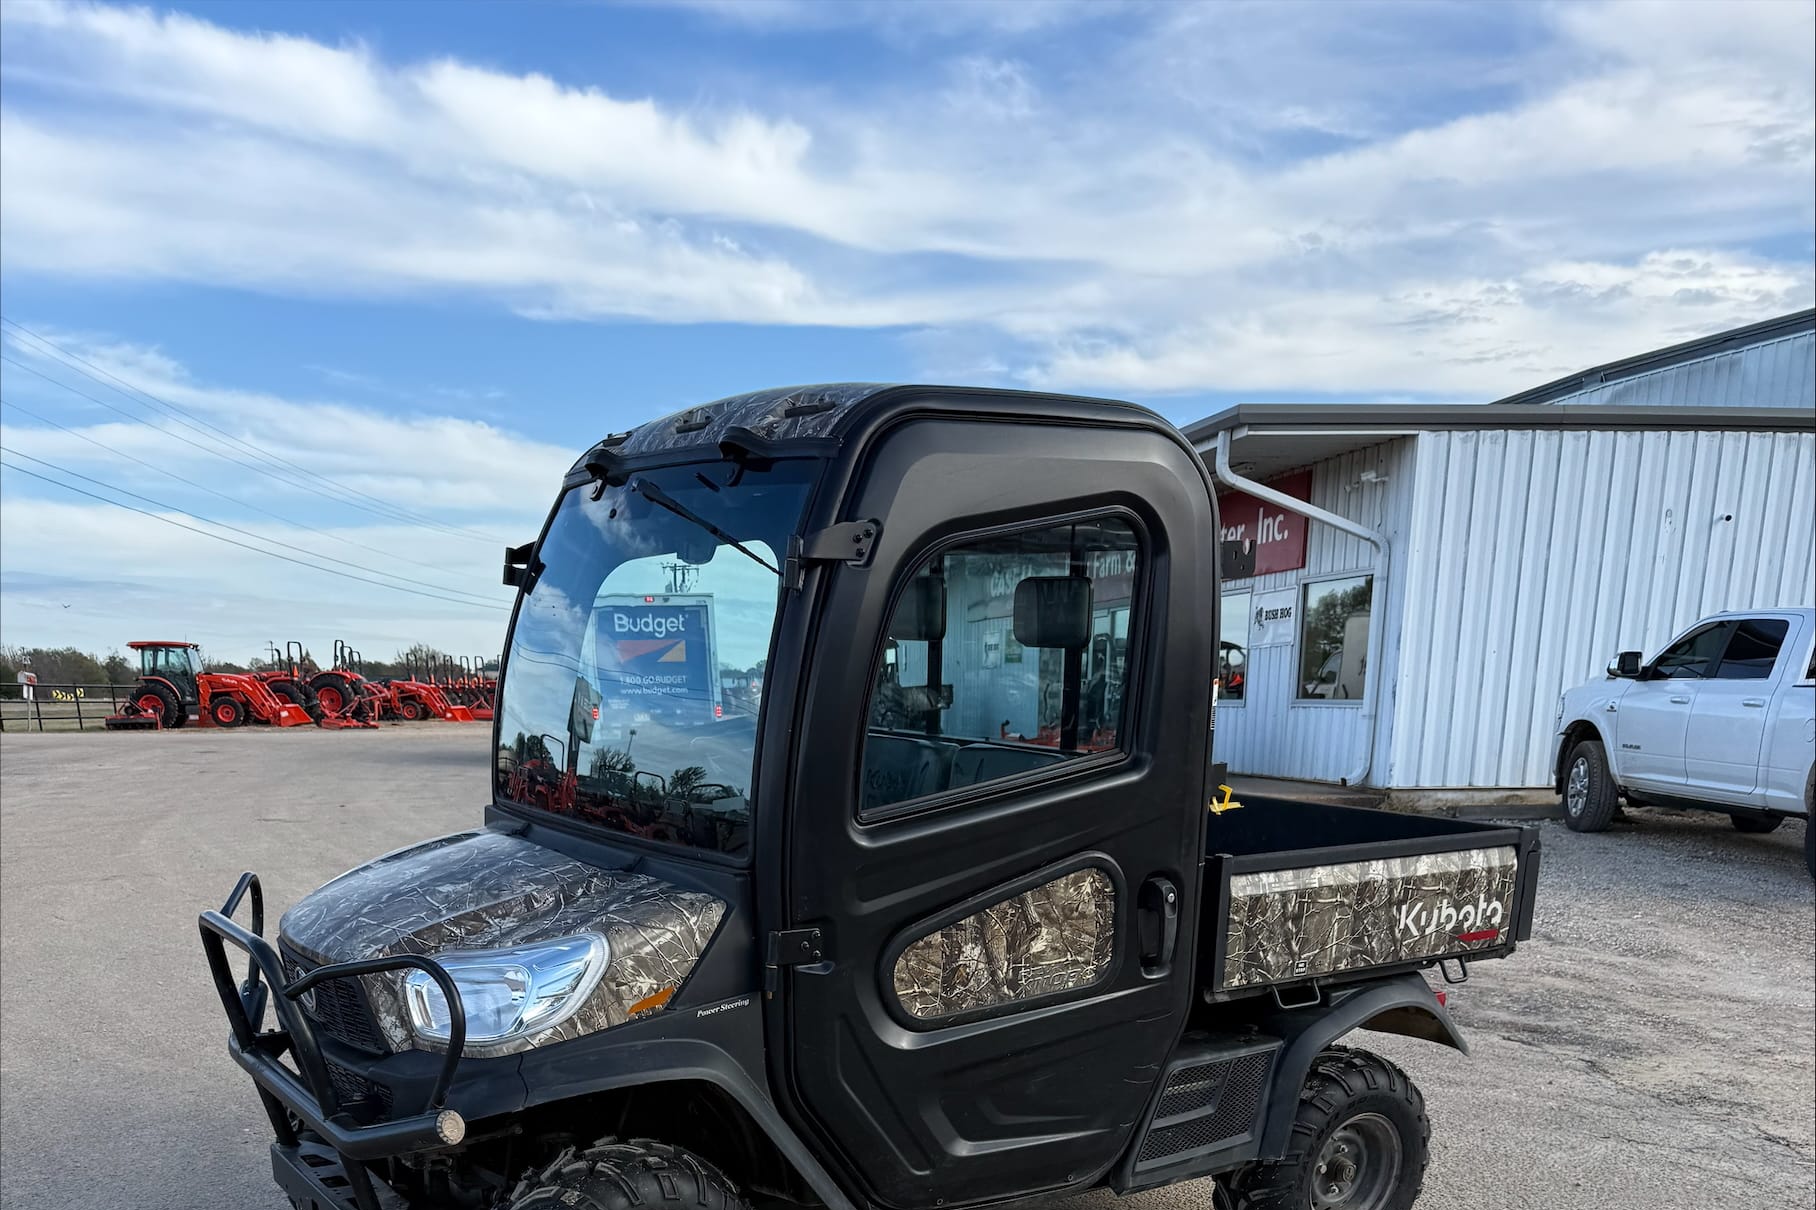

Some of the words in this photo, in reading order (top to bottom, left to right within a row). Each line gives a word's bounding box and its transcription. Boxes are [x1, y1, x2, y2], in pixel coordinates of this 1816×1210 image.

[1257, 507, 1289, 545] Inc.
[1093, 551, 1121, 579] Farm
[614, 613, 686, 638] Budget
[1400, 893, 1502, 936] Kubota
[697, 1007, 720, 1018] Power
[720, 999, 749, 1011] Steering
